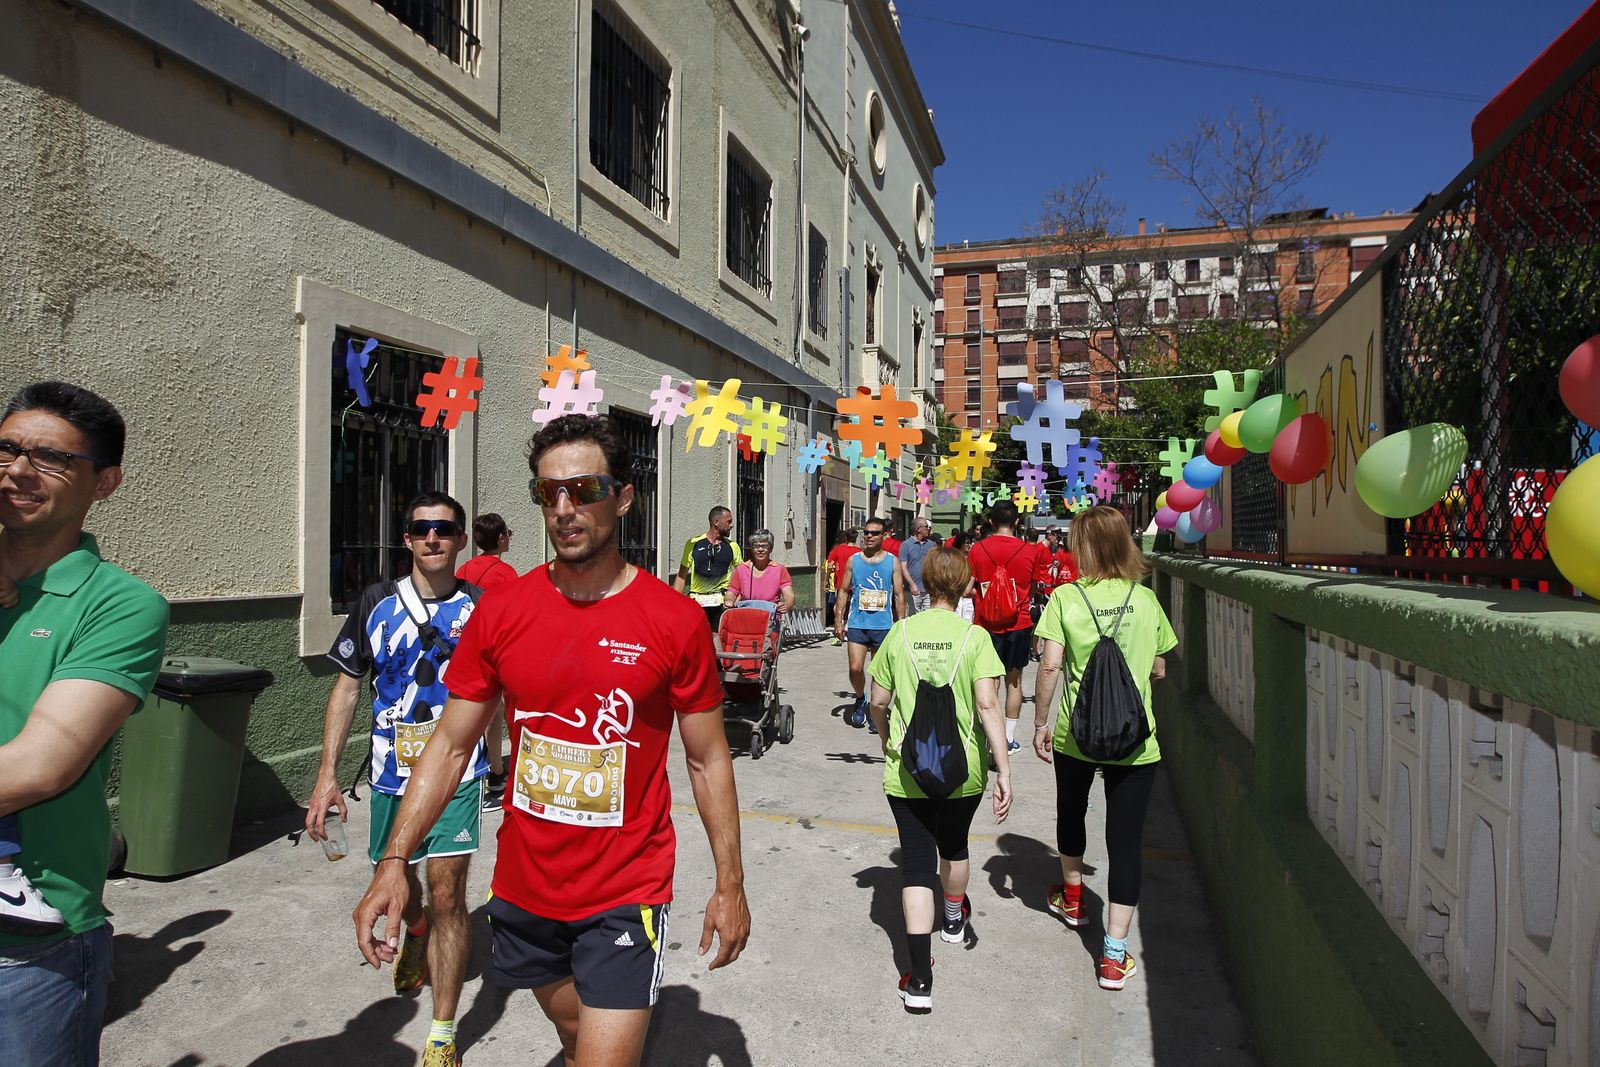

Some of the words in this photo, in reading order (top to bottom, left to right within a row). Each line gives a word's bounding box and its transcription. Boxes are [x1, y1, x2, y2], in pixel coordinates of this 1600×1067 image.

[610, 640, 647, 652] Santander
[523, 759, 604, 798] 3070
[553, 793, 577, 808] MAYO
